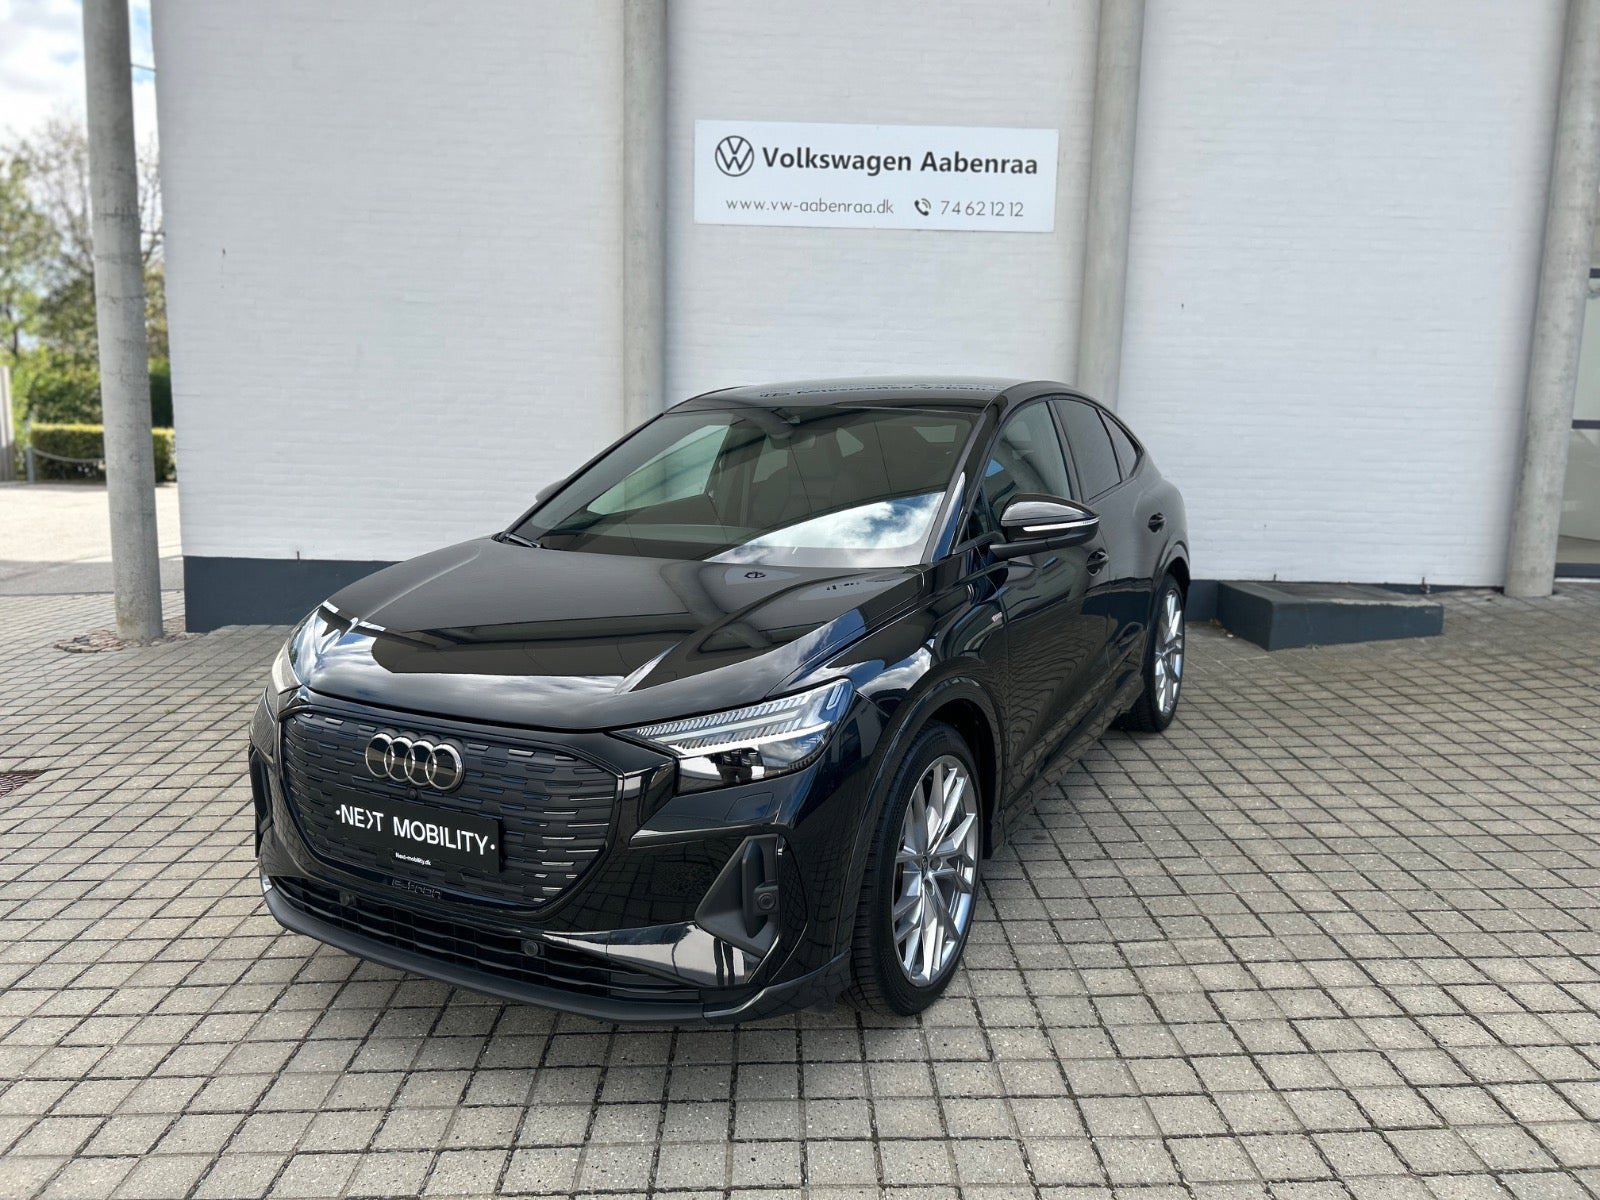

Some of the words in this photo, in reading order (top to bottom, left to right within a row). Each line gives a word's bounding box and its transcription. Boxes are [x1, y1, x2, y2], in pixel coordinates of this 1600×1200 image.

[762, 146, 912, 177] Volkswagen
[920, 151, 1038, 175] Aabenraa
[725, 197, 894, 214] www.vw-aabenraa.dk
[393, 816, 489, 856] MOBILITY
